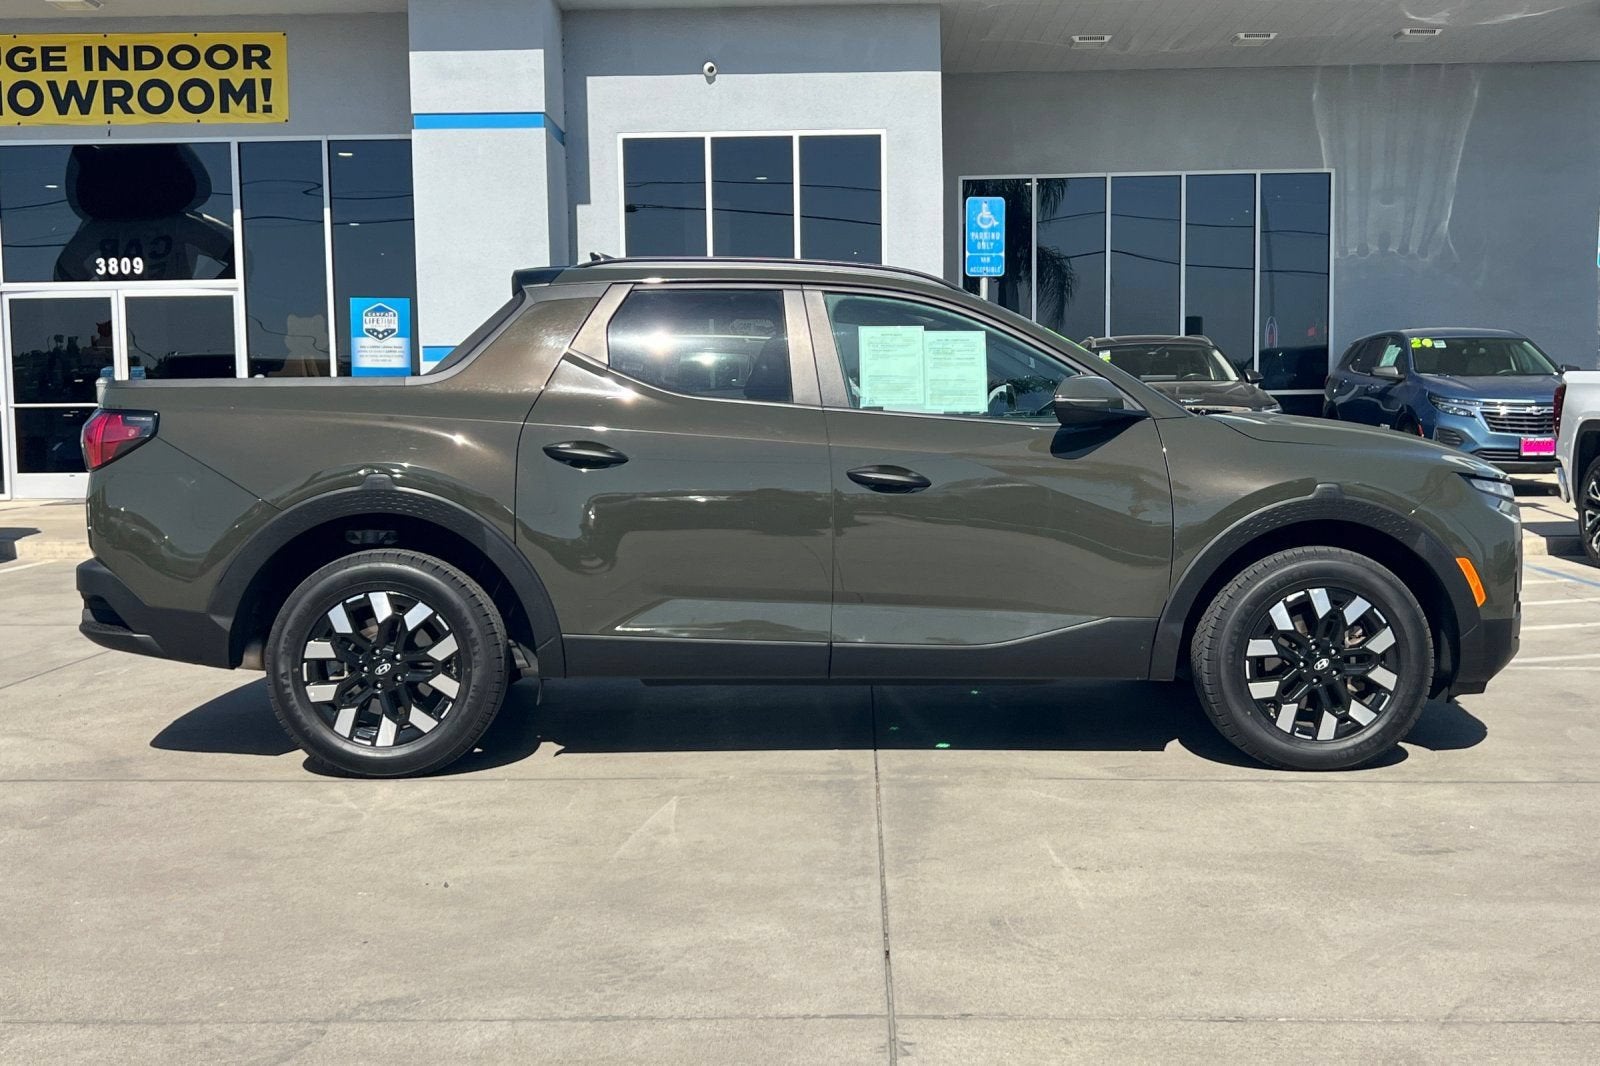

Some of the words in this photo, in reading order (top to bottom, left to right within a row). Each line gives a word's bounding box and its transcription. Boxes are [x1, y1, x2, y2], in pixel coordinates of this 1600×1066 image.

[0, 45, 68, 72] GE
[83, 43, 273, 72] INDOOR
[976, 242, 993, 250] ONLY
[95, 256, 144, 275] 3809
[364, 317, 397, 325] LIFETIME
